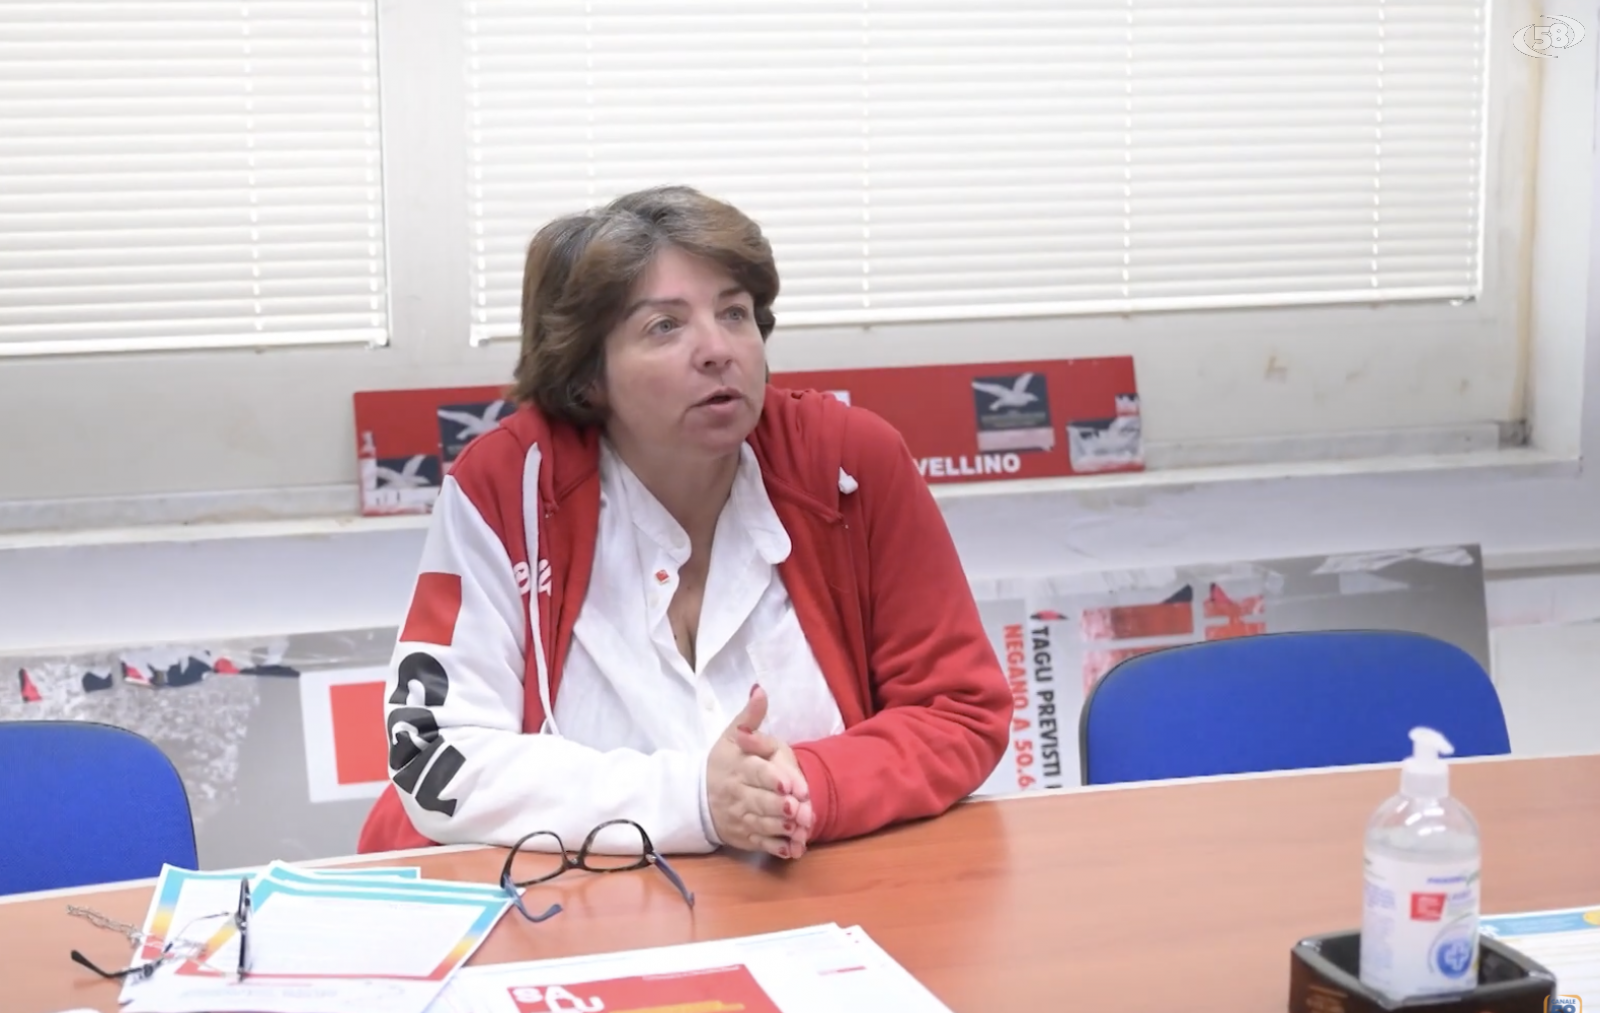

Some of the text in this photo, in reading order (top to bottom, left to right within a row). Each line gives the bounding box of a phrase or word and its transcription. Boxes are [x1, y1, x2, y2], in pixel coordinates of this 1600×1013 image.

[913, 453, 1021, 476] VELLINO
[388, 652, 466, 818] CGIL
[1003, 624, 1036, 790] NEGANO A 50.6
[1036, 690, 1062, 777] PREVISTI
